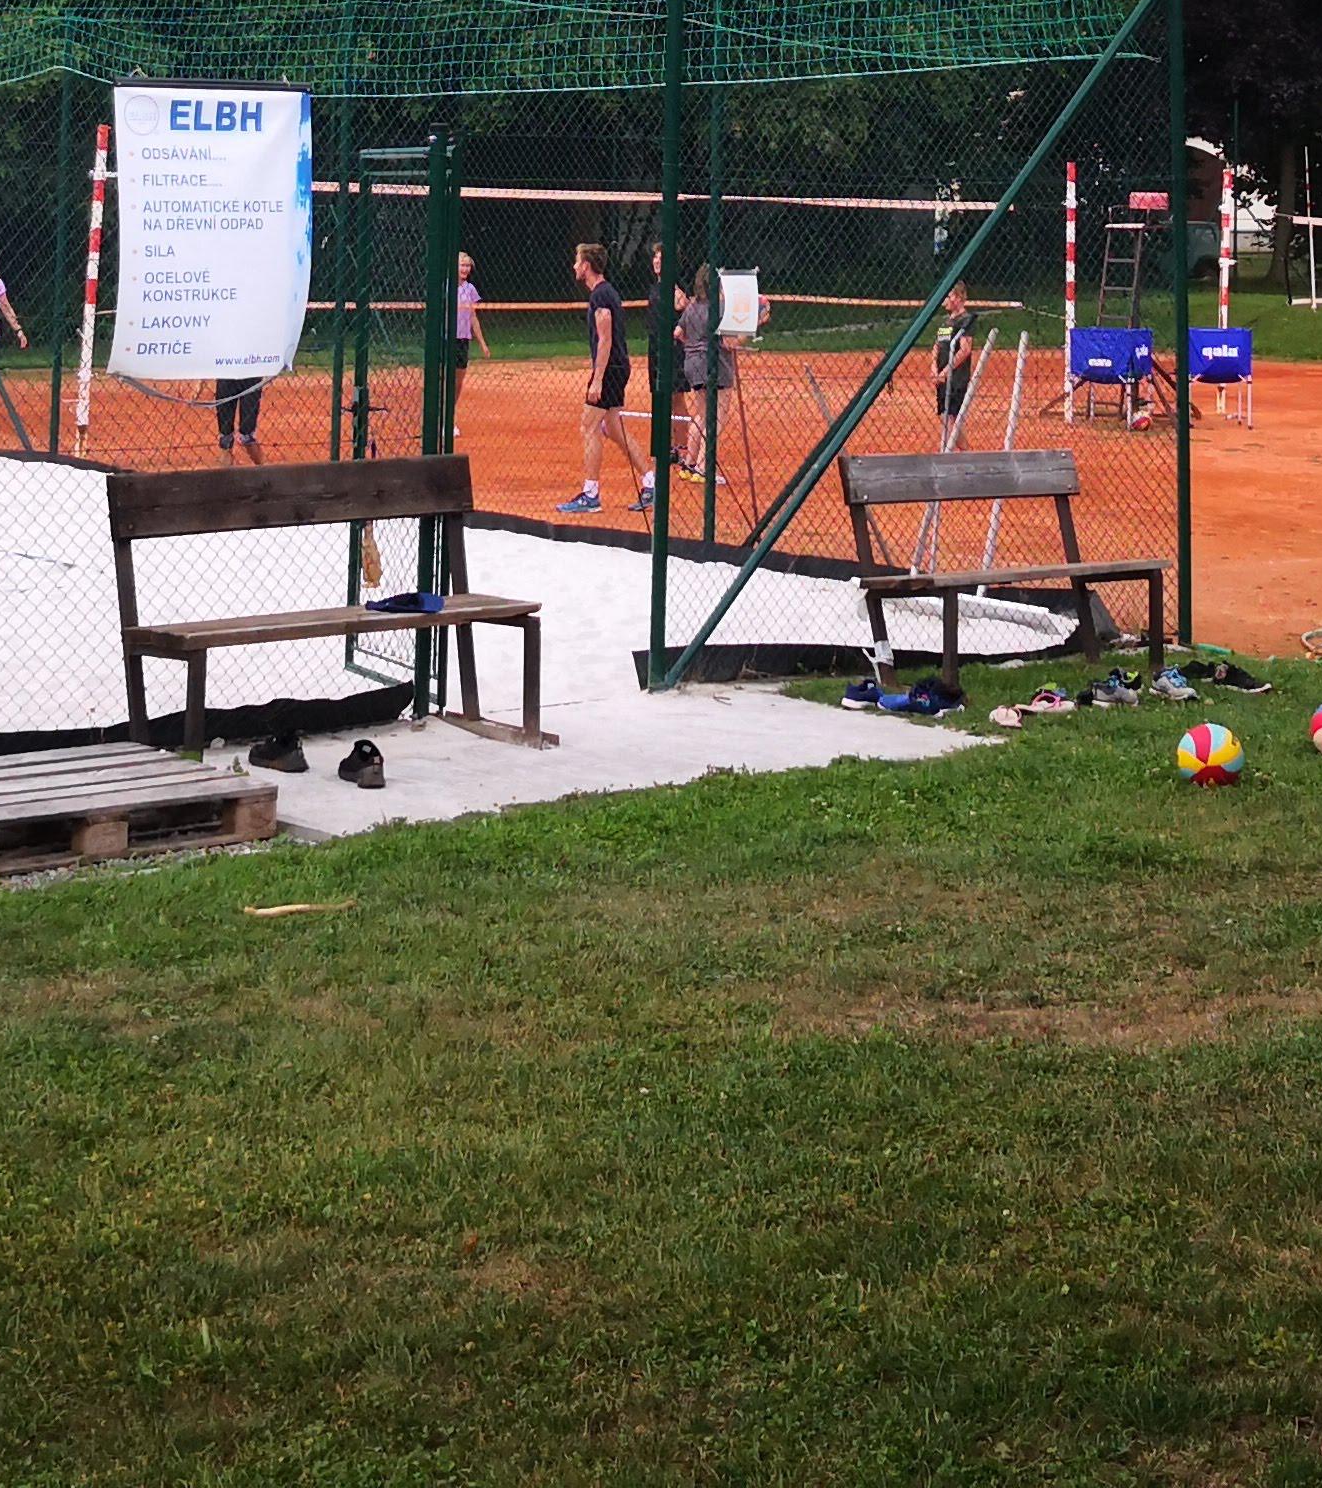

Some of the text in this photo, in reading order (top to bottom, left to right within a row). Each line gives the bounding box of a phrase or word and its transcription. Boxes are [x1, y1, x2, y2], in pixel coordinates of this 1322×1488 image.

[169, 99, 263, 131] ELBH
[143, 197, 283, 213] AUTOMATICKÉ KOTLE
[143, 215, 263, 230] NA DŘEVNÍ ODPAD
[144, 245, 175, 257] SILA
[144, 269, 210, 284] OCELOVÉ
[143, 288, 237, 302] KONSTRUKCE
[142, 315, 211, 329] LAKOVNY
[136, 340, 192, 355] DRTIČE
